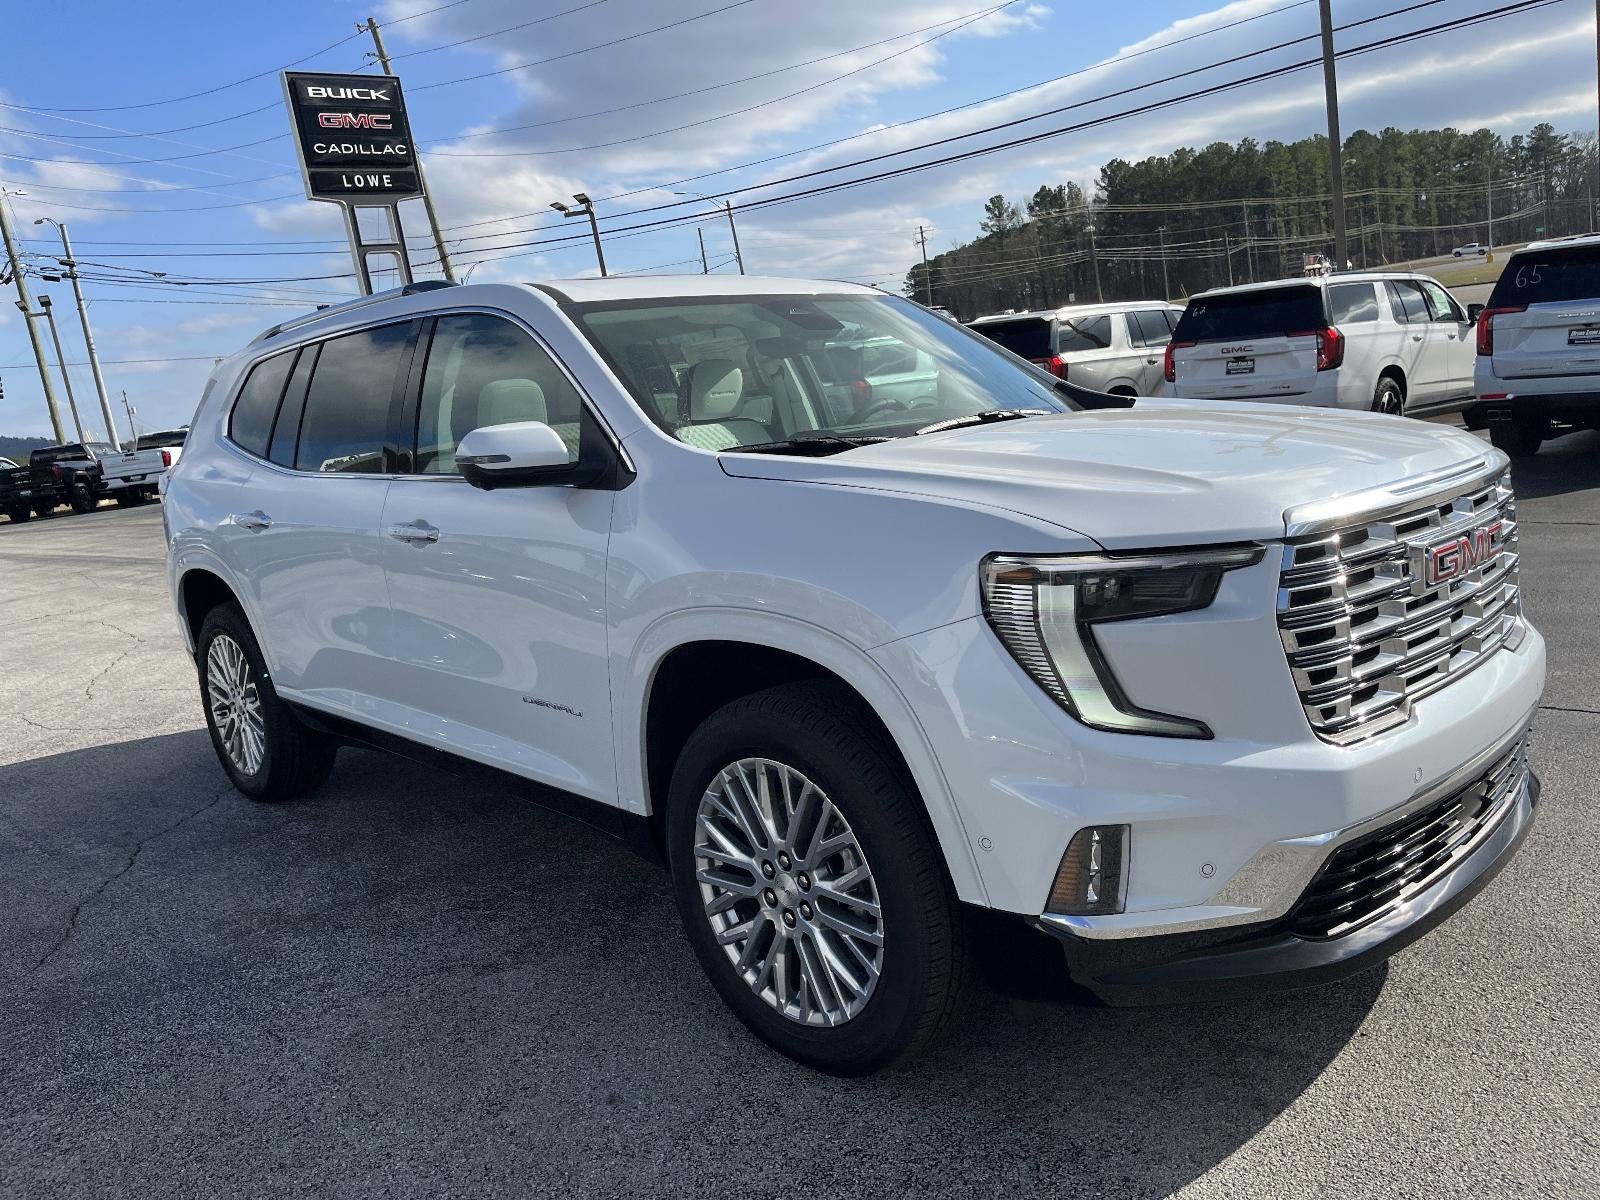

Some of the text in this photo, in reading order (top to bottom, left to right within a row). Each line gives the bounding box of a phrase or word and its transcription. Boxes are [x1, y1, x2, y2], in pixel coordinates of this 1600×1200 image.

[307, 86, 391, 101] BUICK
[318, 112, 393, 130] GMC
[313, 143, 407, 155] CADILLAC
[342, 174, 393, 188] LOWE
[1515, 264, 1549, 288] 65
[1221, 345, 1254, 354] GMC
[1431, 521, 1504, 583] GMC
